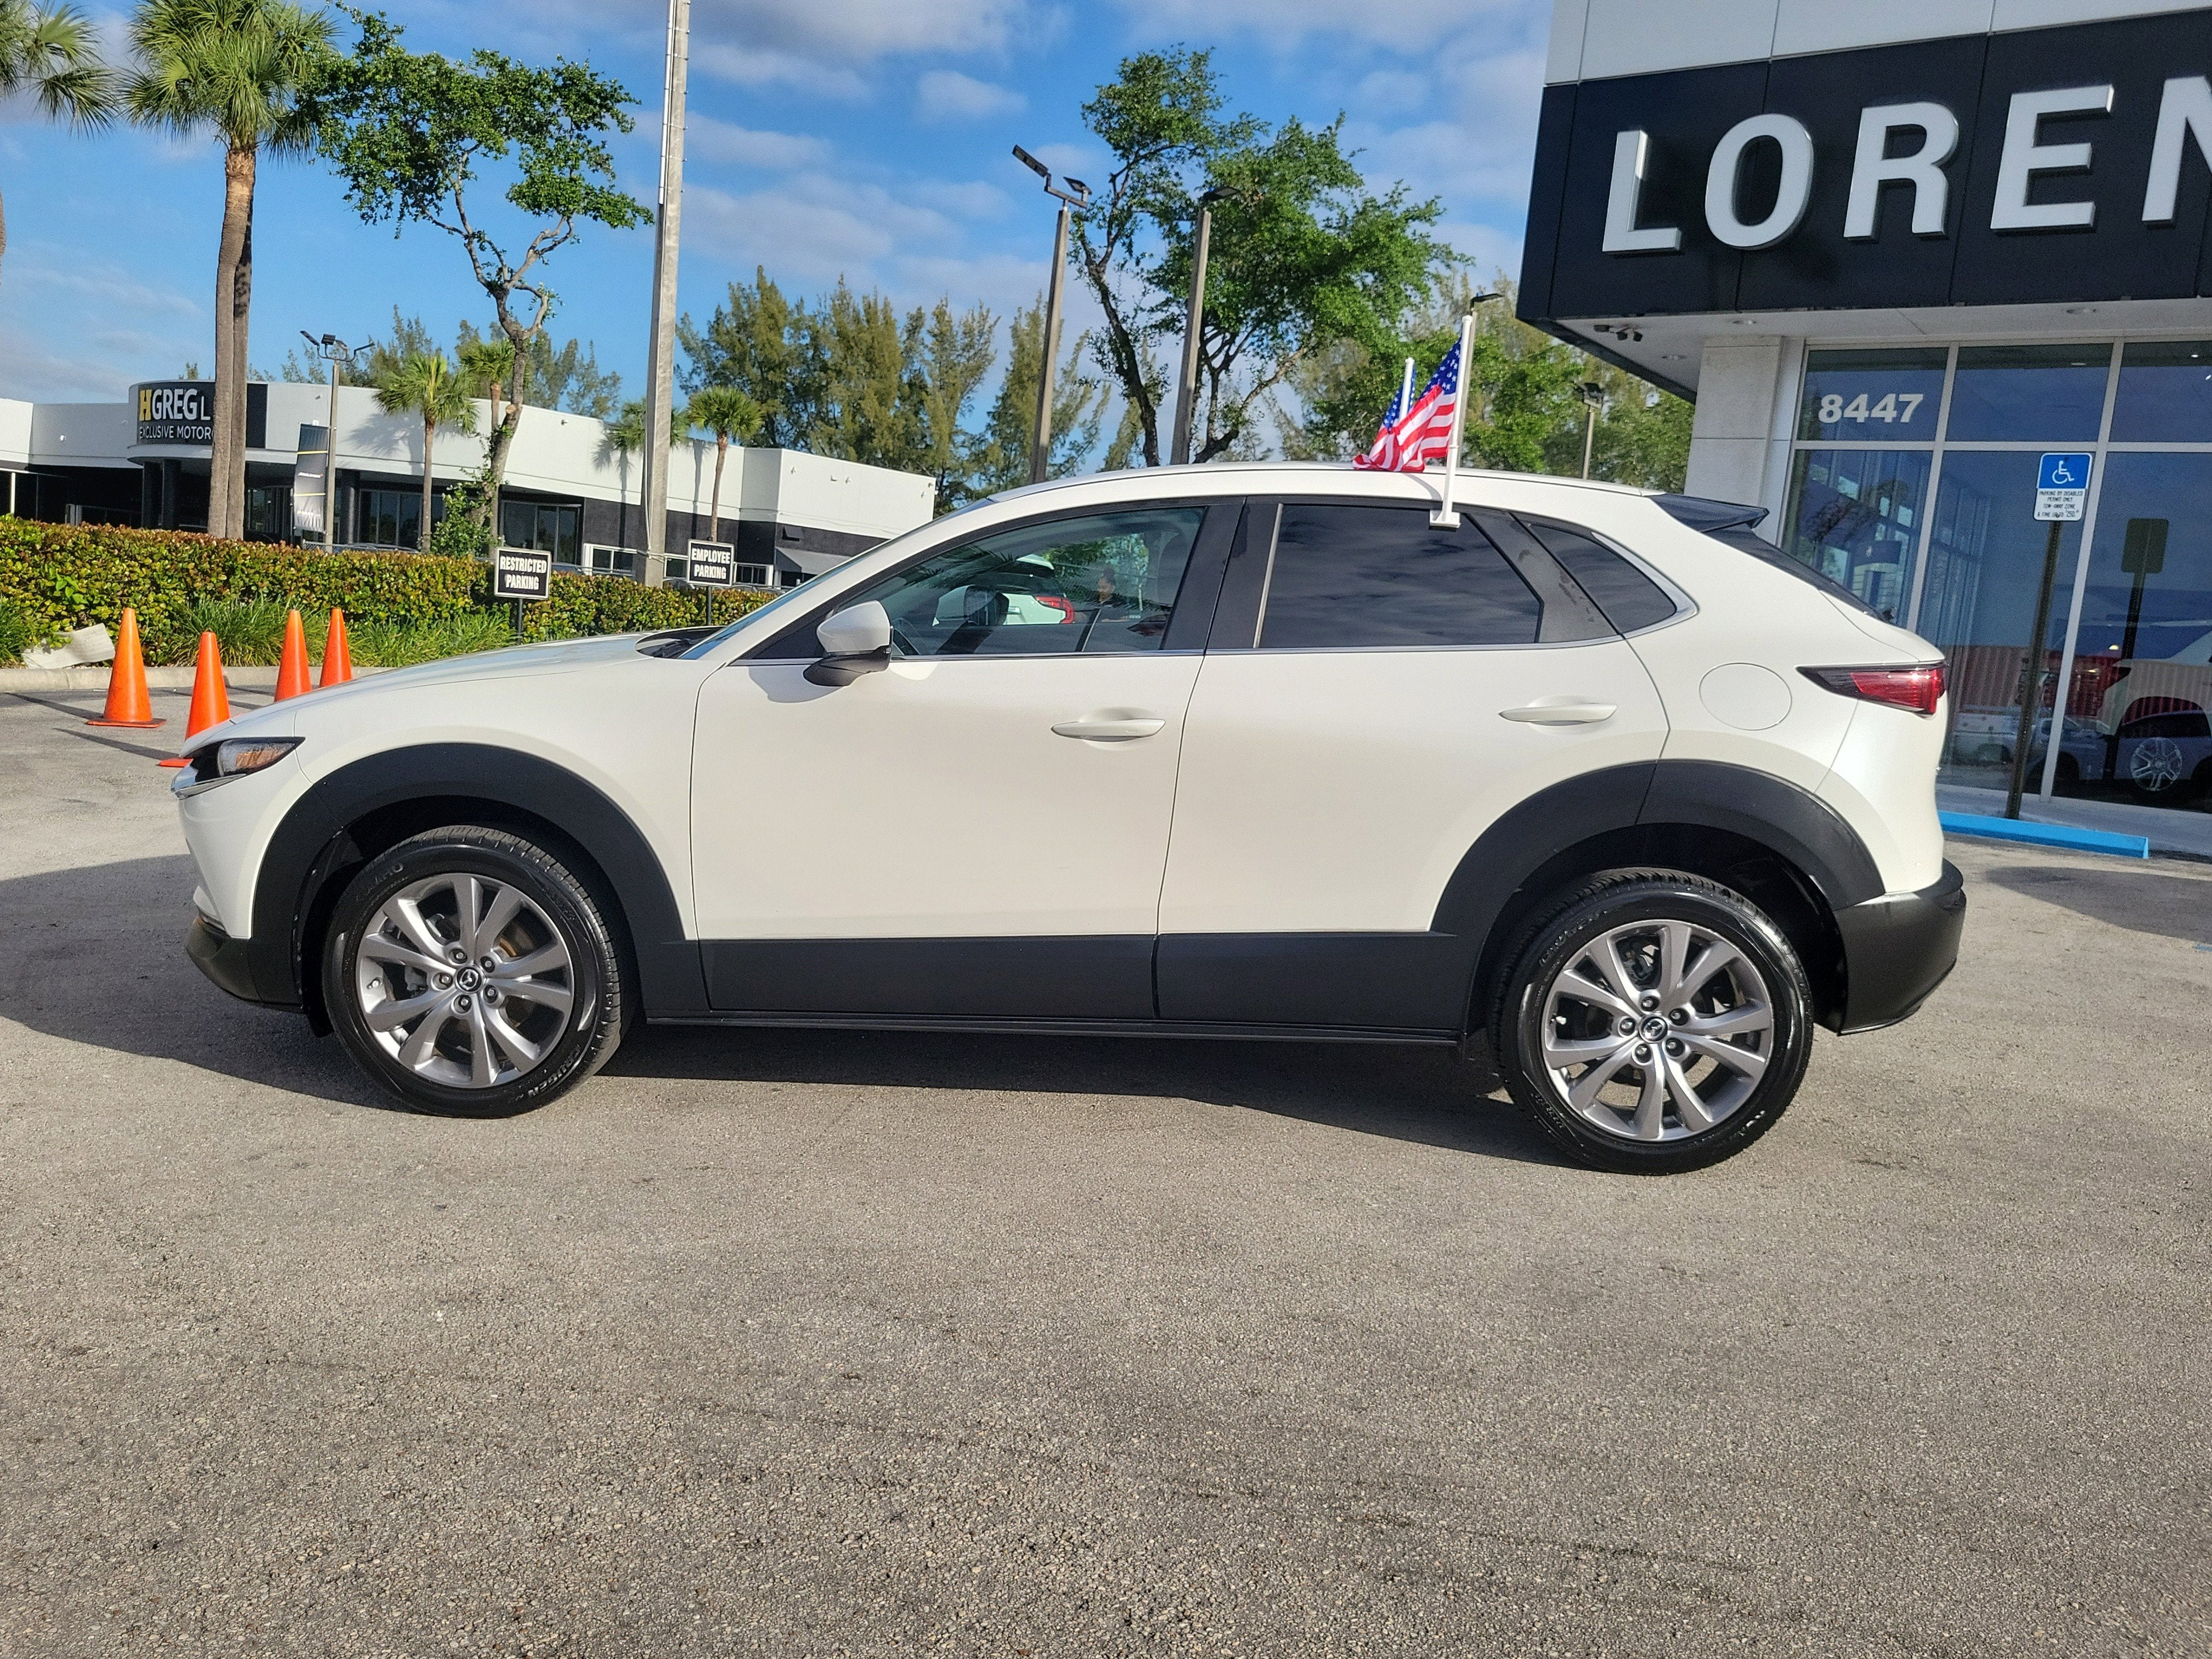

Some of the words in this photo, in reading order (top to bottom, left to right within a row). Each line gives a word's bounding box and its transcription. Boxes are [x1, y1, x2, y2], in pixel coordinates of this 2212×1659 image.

[139, 388, 198, 421] HGREG
[1818, 393, 1924, 424] 8447
[139, 425, 174, 439] EXCLUSIVE
[177, 425, 214, 439] MOTOR
[500, 556, 547, 574] RESTRICTED
[691, 548, 731, 565] EMPLOYEE
[693, 564, 727, 580] PARKING
[506, 574, 539, 590] PARKING
